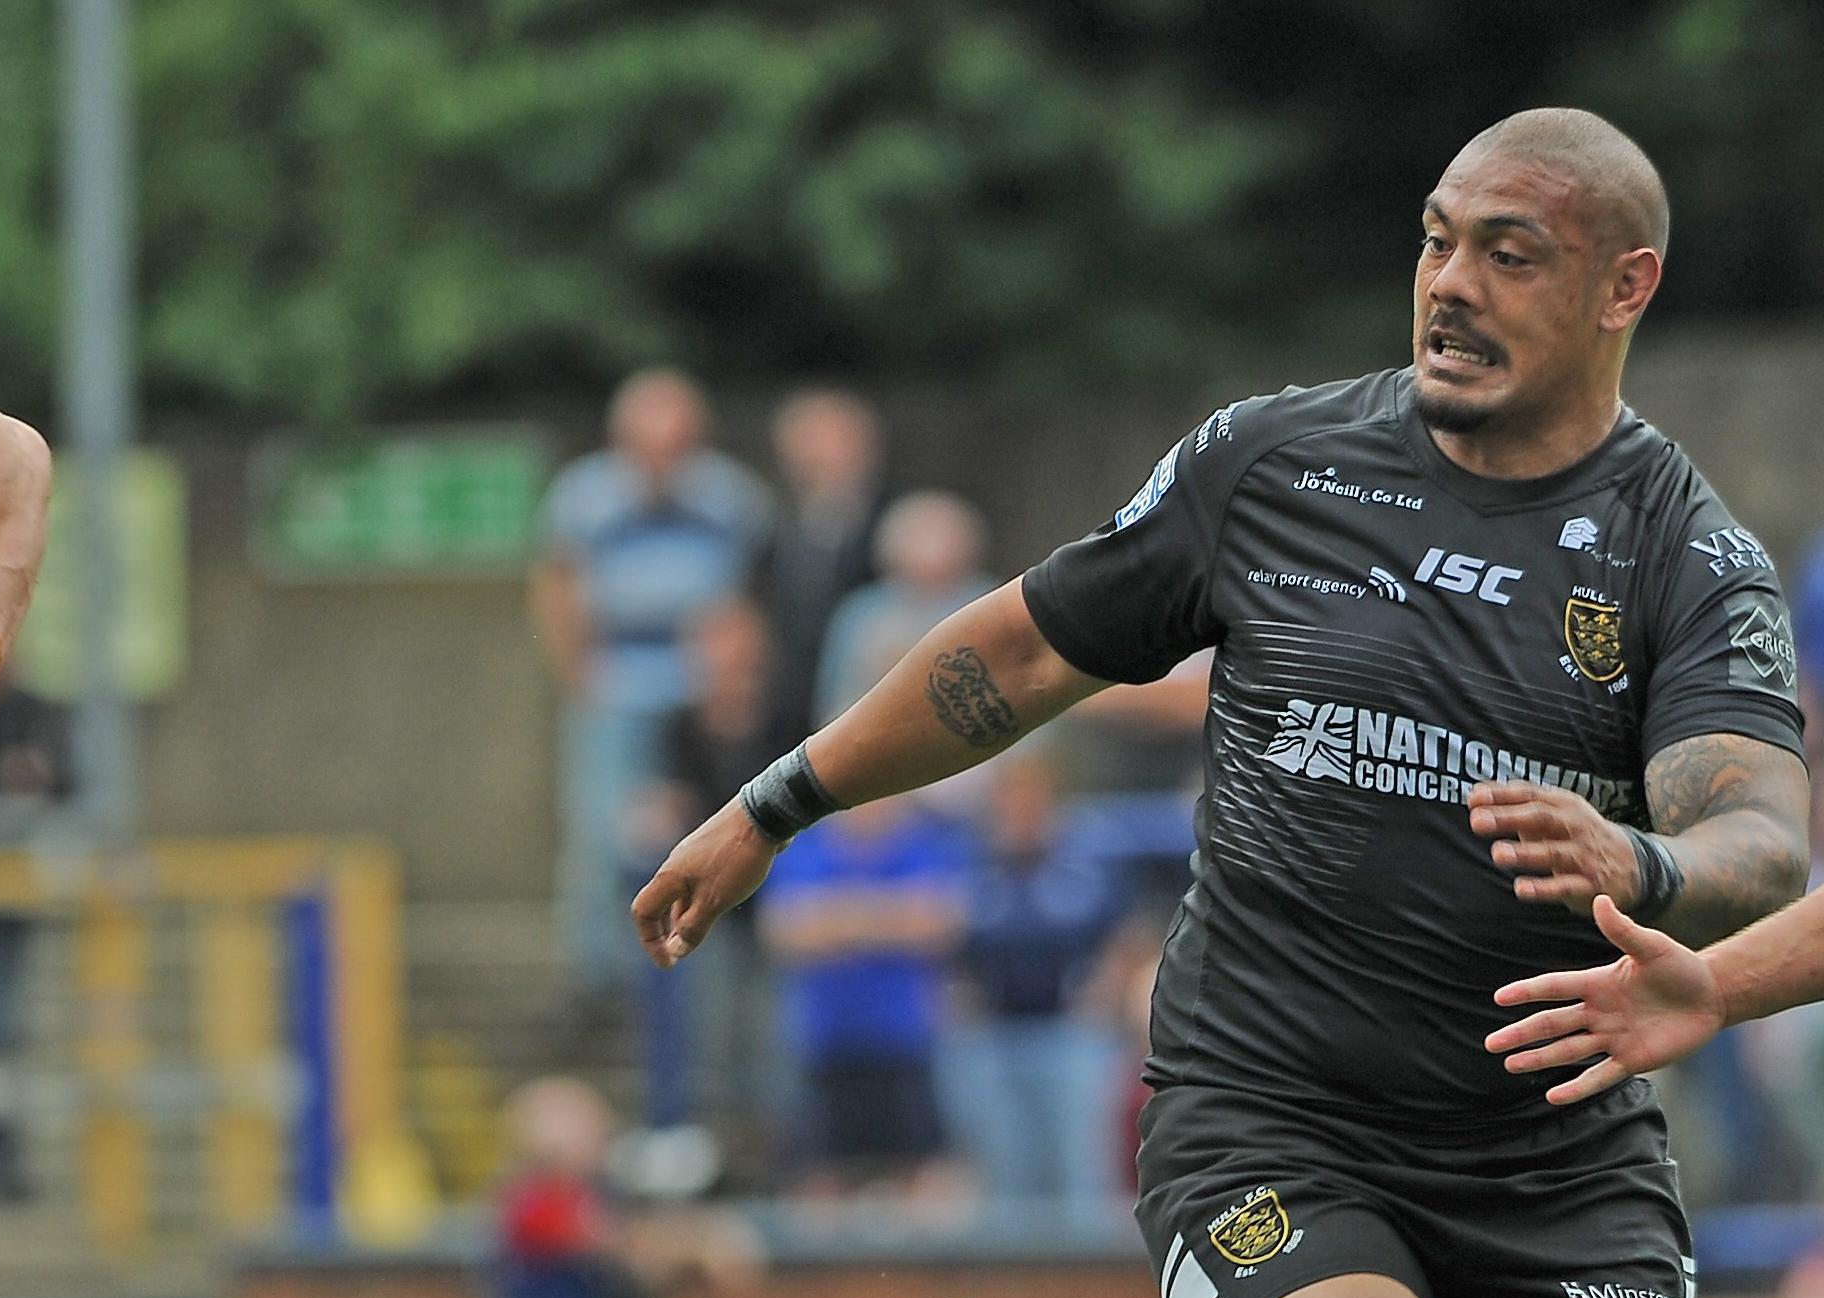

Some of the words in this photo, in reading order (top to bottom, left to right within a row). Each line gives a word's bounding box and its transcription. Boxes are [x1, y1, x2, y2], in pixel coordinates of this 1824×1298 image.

[1395, 494, 1423, 511] Ltd
[1247, 569, 1277, 588] relay
[1279, 573, 1310, 589] port
[1311, 577, 1368, 600] agency
[1413, 547, 1523, 606] ISC
[1572, 585, 1606, 604] HULL
